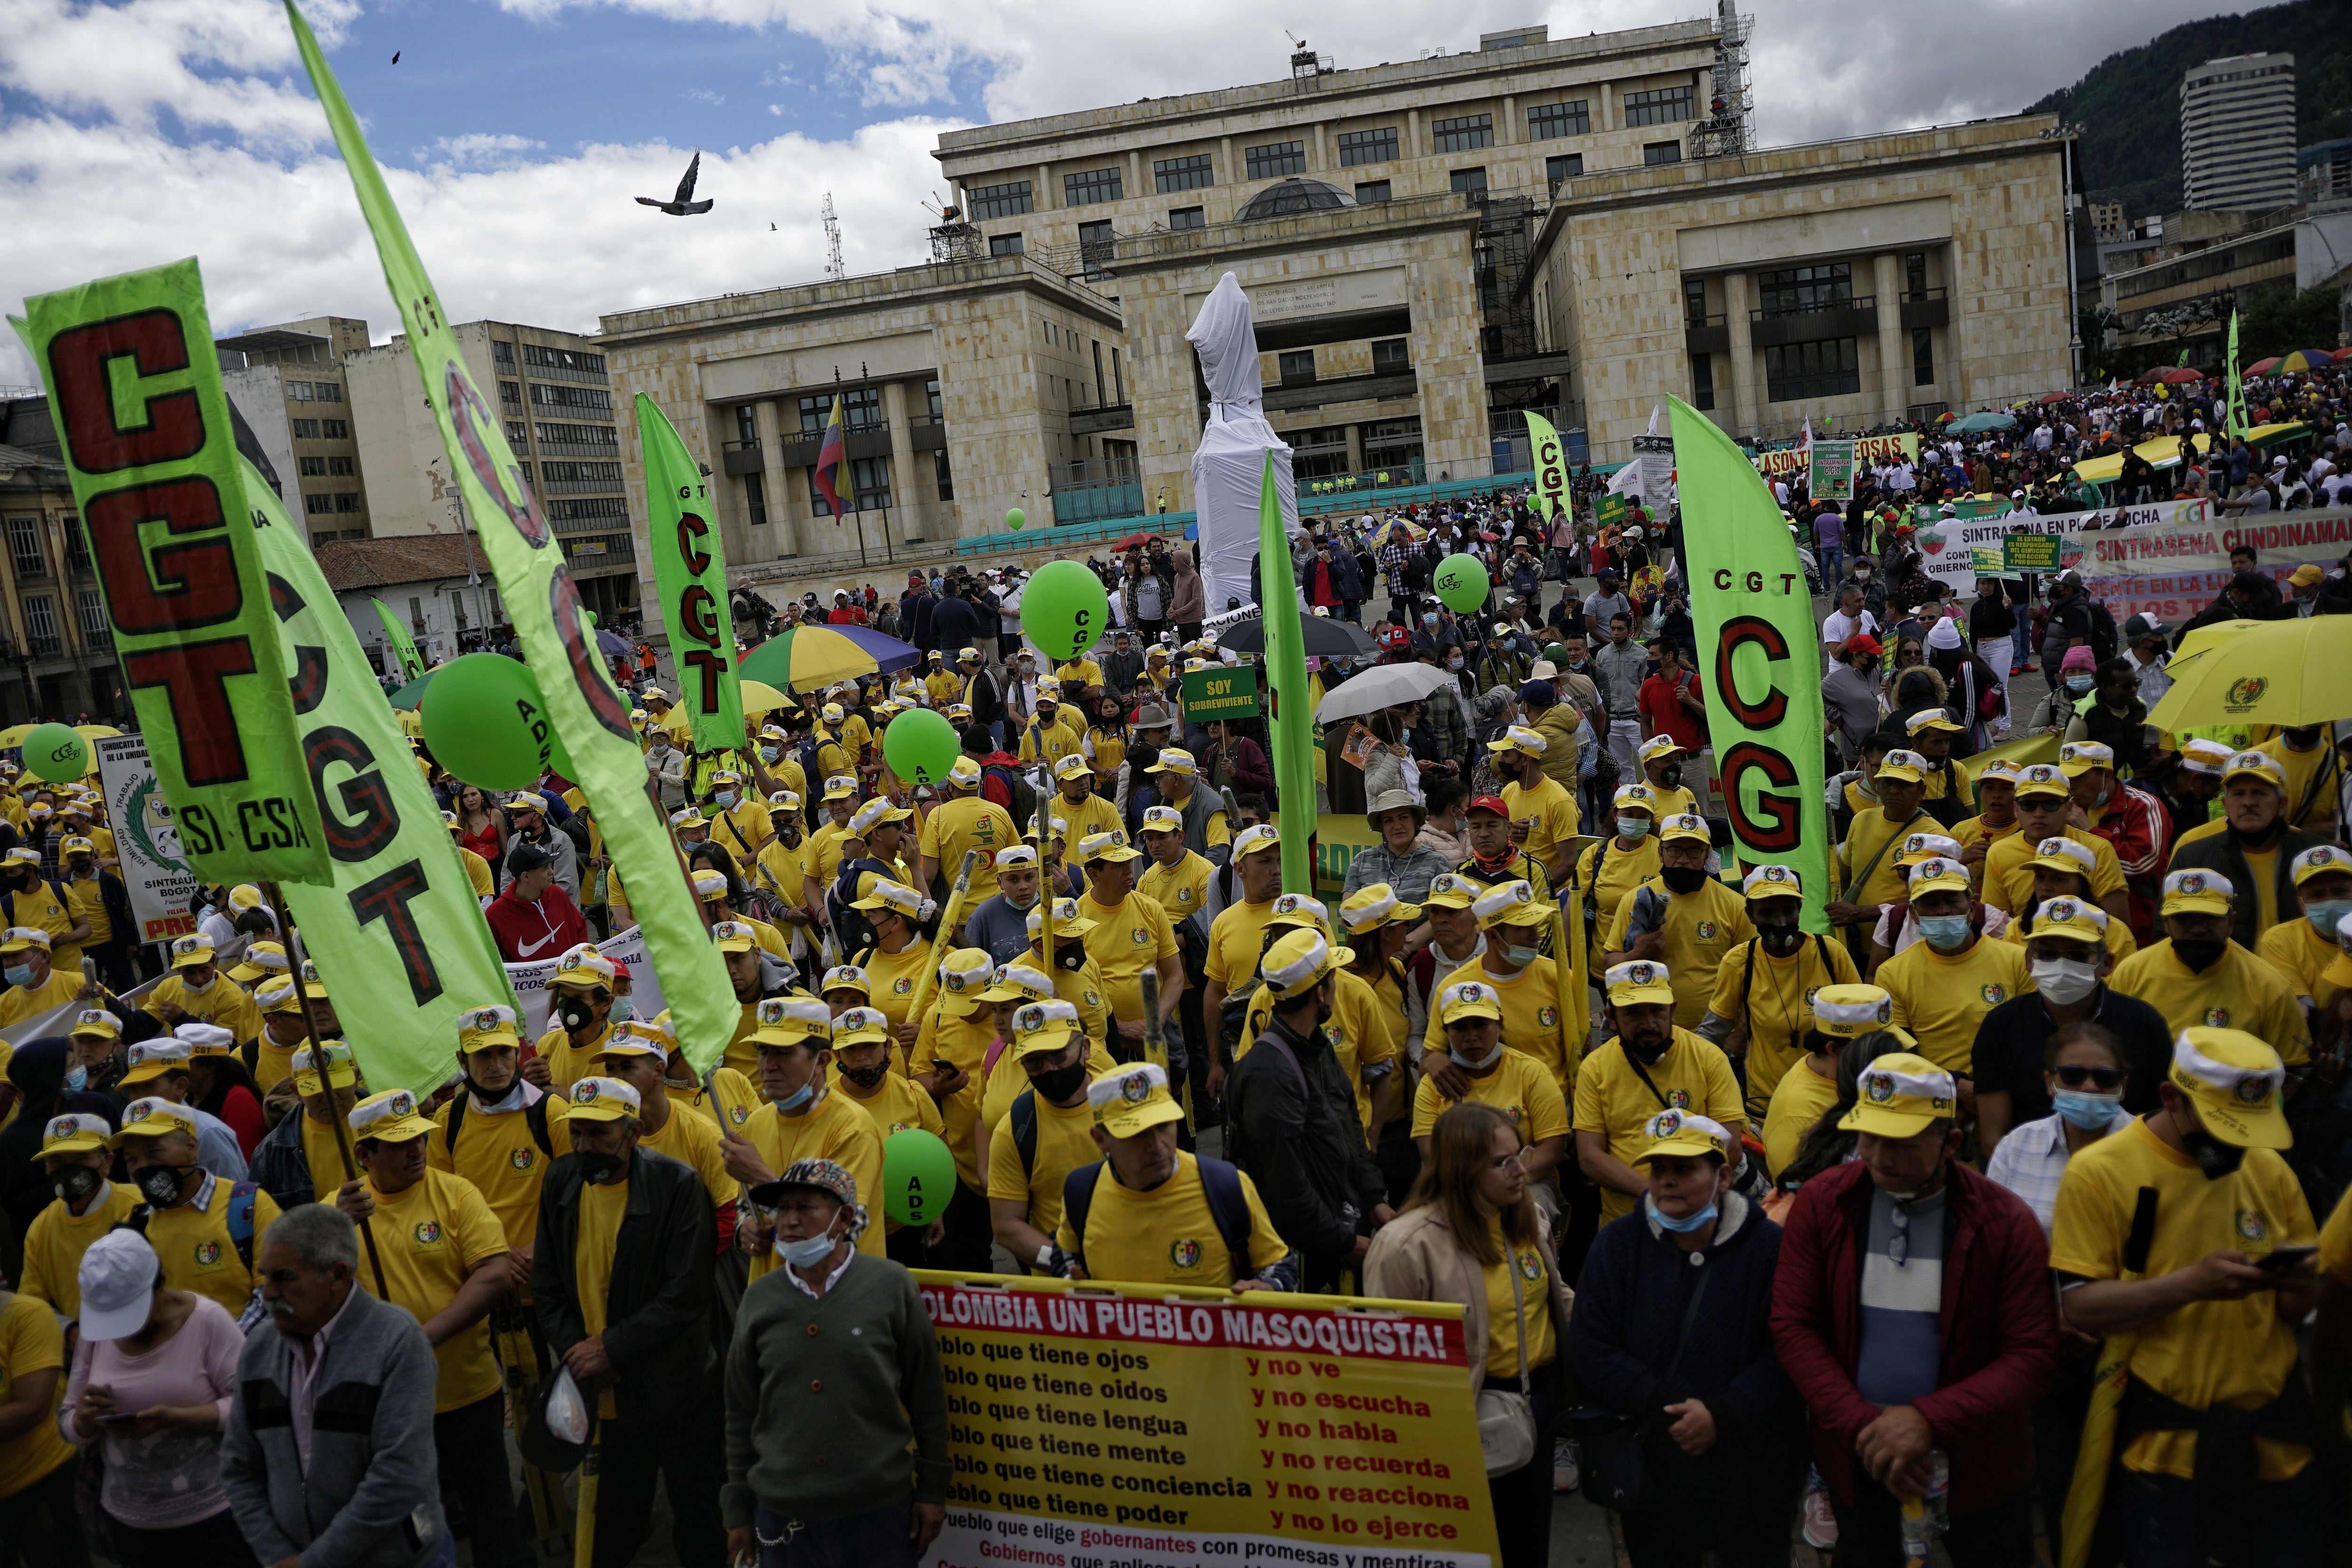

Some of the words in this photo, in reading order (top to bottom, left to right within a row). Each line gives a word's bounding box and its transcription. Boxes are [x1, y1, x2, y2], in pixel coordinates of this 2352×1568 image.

[1295, 292, 1335, 301] INDEPENDENCIA
[1541, 442, 1563, 505] CGT
[1599, 509, 1625, 521] SOBREVIVIENTE
[1605, 500, 1616, 510] SOY
[2048, 521, 2064, 534] EN
[2175, 500, 2208, 526] CGT
[48, 306, 257, 788] CGT
[2096, 531, 2219, 562] SINTRASENA
[1714, 569, 1796, 595] CGT
[2150, 578, 2173, 593] EN
[2179, 575, 2202, 592] LA
[676, 511, 728, 714] CGT
[1072, 610, 1089, 655] CGT
[1206, 679, 1232, 696] SOY
[1189, 695, 1253, 711] SOBREVIVIENTE
[516, 698, 550, 765] ADS
[102, 739, 135, 751] SINDICATO
[1513, 741, 1525, 751] CGT
[916, 765, 930, 785] AD
[116, 773, 138, 809] TRABAJO
[117, 828, 147, 868] HUMILDAD
[2078, 863, 2091, 875] CGT
[883, 898, 898, 909] CGT
[598, 971, 610, 982] CGT
[1022, 987, 1038, 998] CGT
[807, 1023, 824, 1035] CGT
[1066, 1019, 1079, 1027] CGT
[1831, 1023, 1853, 1034] UTRADEC
[650, 1040, 664, 1052] CGT
[623, 1102, 636, 1115] CGT
[1933, 1098, 1952, 1110] CGT
[174, 1118, 190, 1129] CGT
[907, 1176, 923, 1220] ADS
[920, 1290, 1044, 1331] OLOMBIA
[1048, 1299, 1090, 1334] UN
[1096, 1301, 1214, 1342] PUEBLO
[1221, 1309, 1447, 1360] MASOQUISTA!
[982, 1343, 1023, 1362] que
[1030, 1343, 1089, 1366] tiene
[1097, 1348, 1149, 1372] ojos
[1247, 1357, 1259, 1376] y
[1268, 1359, 1302, 1376] no
[1309, 1361, 1340, 1378] ve
[985, 1372, 1026, 1392] que
[1033, 1373, 1092, 1397] tiene
[1101, 1379, 1168, 1403] oidos
[1251, 1388, 1265, 1407] y
[1273, 1390, 1306, 1407] no
[1315, 1391, 1431, 1418] escucha
[988, 1402, 1029, 1422] que
[1036, 1404, 1096, 1427] tiene
[1104, 1410, 1188, 1437] lengua
[1256, 1419, 1270, 1437] y
[1278, 1421, 1311, 1439] no
[1319, 1419, 1398, 1443] habla
[991, 1431, 1033, 1451] que
[1040, 1433, 1100, 1457] tiene
[1108, 1443, 1186, 1465] mente
[1261, 1449, 1274, 1468] y
[1282, 1451, 1315, 1470] no
[1324, 1454, 1451, 1479] recuerda
[995, 1460, 1037, 1480] que
[1043, 1464, 1104, 1487] tiene
[1112, 1474, 1252, 1497] conciencia
[1265, 1480, 1279, 1498] y
[1287, 1482, 1320, 1501] no
[1328, 1485, 1470, 1511] reacciona
[998, 1490, 1040, 1510] que
[1047, 1494, 1108, 1518] tiene
[1115, 1504, 1188, 1525] poder
[1270, 1510, 1284, 1529] y
[1292, 1512, 1325, 1531] no
[1332, 1514, 1359, 1534] lo
[1367, 1515, 1457, 1541] ejerce
[979, 1540, 1065, 1567] Gobiernos
[1071, 1555, 1104, 1568] que
[997, 1519, 1028, 1537] que
[1033, 1521, 1075, 1544] elige
[1080, 1529, 1197, 1554] gobernantes
[1202, 1539, 1238, 1554] con
[1245, 1541, 1339, 1567] promesas
[1344, 1554, 1356, 1568] y
